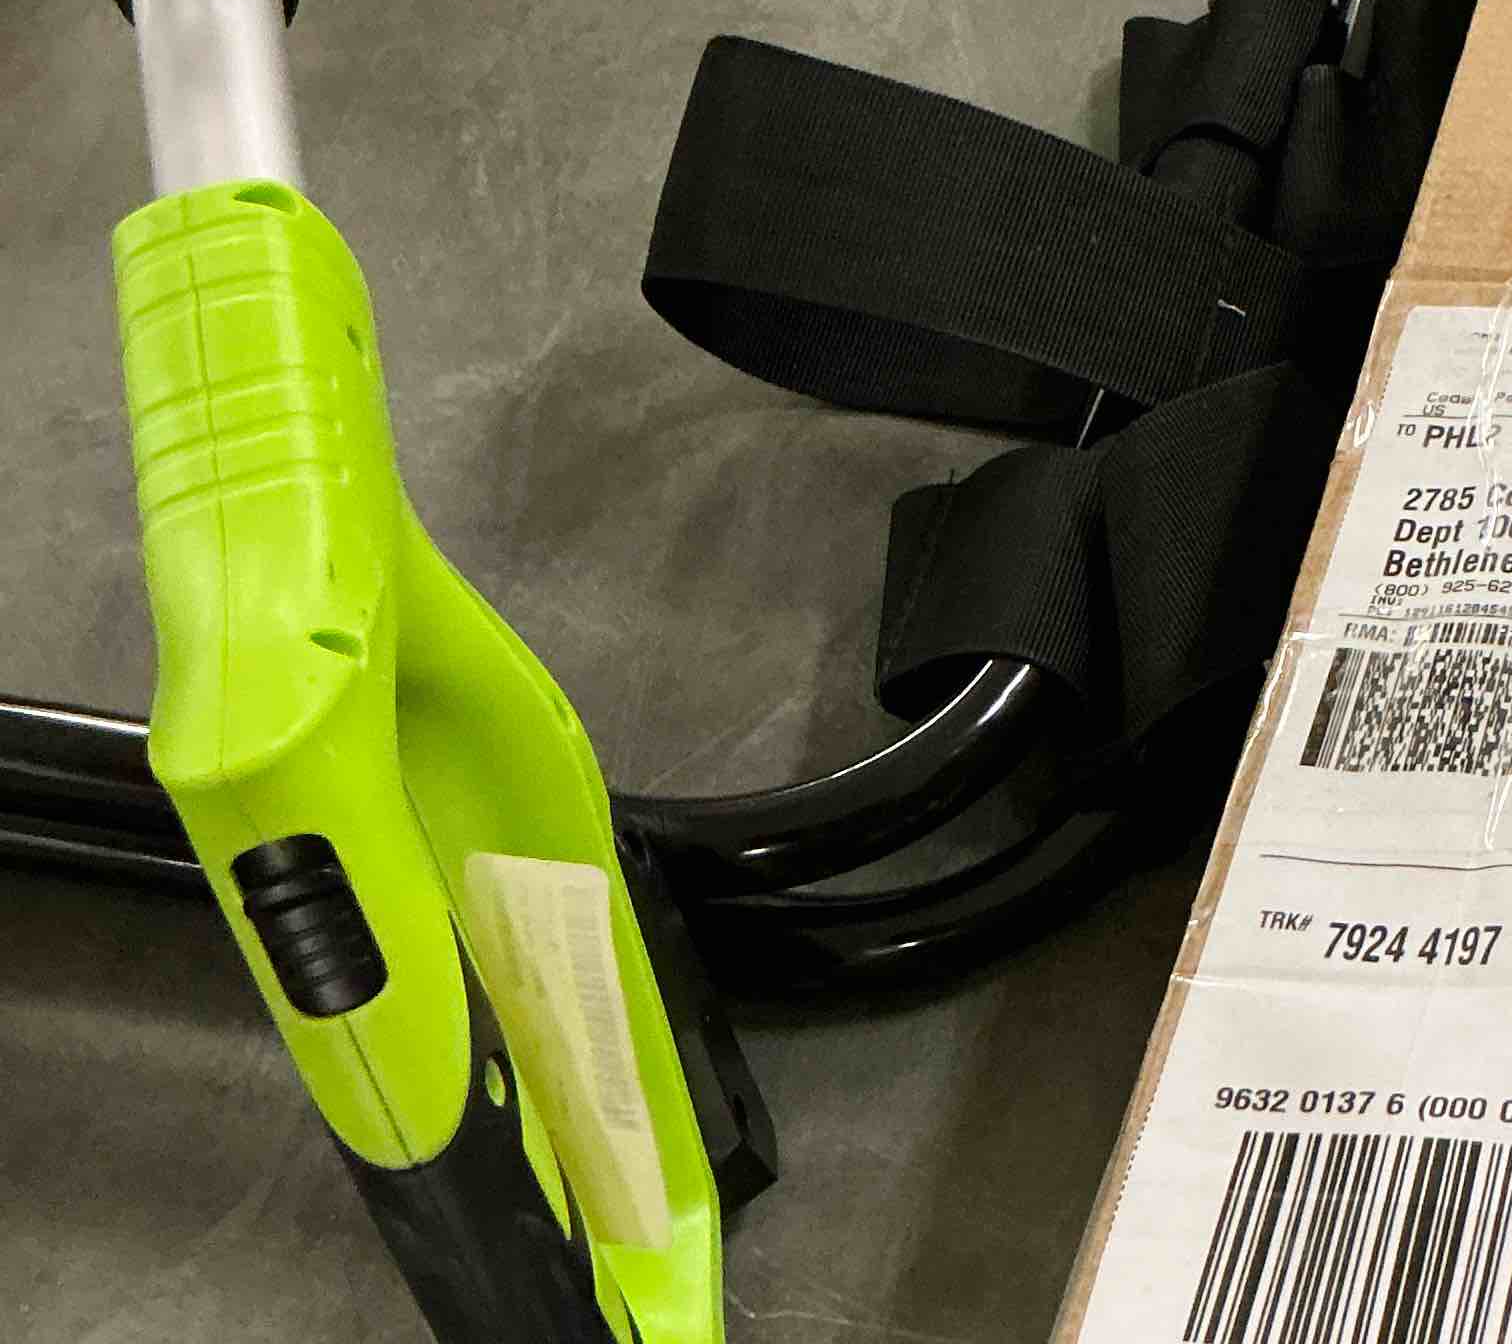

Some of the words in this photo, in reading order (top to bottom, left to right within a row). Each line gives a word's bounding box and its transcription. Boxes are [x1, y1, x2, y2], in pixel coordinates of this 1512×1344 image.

[1397, 423, 1416, 436] TO
[1403, 486, 1477, 511] 2785
[1393, 518, 1465, 549] Dept
[1375, 583, 1429, 597] (800)
[1259, 910, 1313, 932] TRK#
[1324, 922, 1409, 963] 7924
[1418, 925, 1503, 966] 4197
[1214, 1086, 1290, 1113] 9632
[1298, 1089, 1376, 1115] 0137
[1386, 1093, 1406, 1115] 6
[1417, 1094, 1488, 1122] (000
